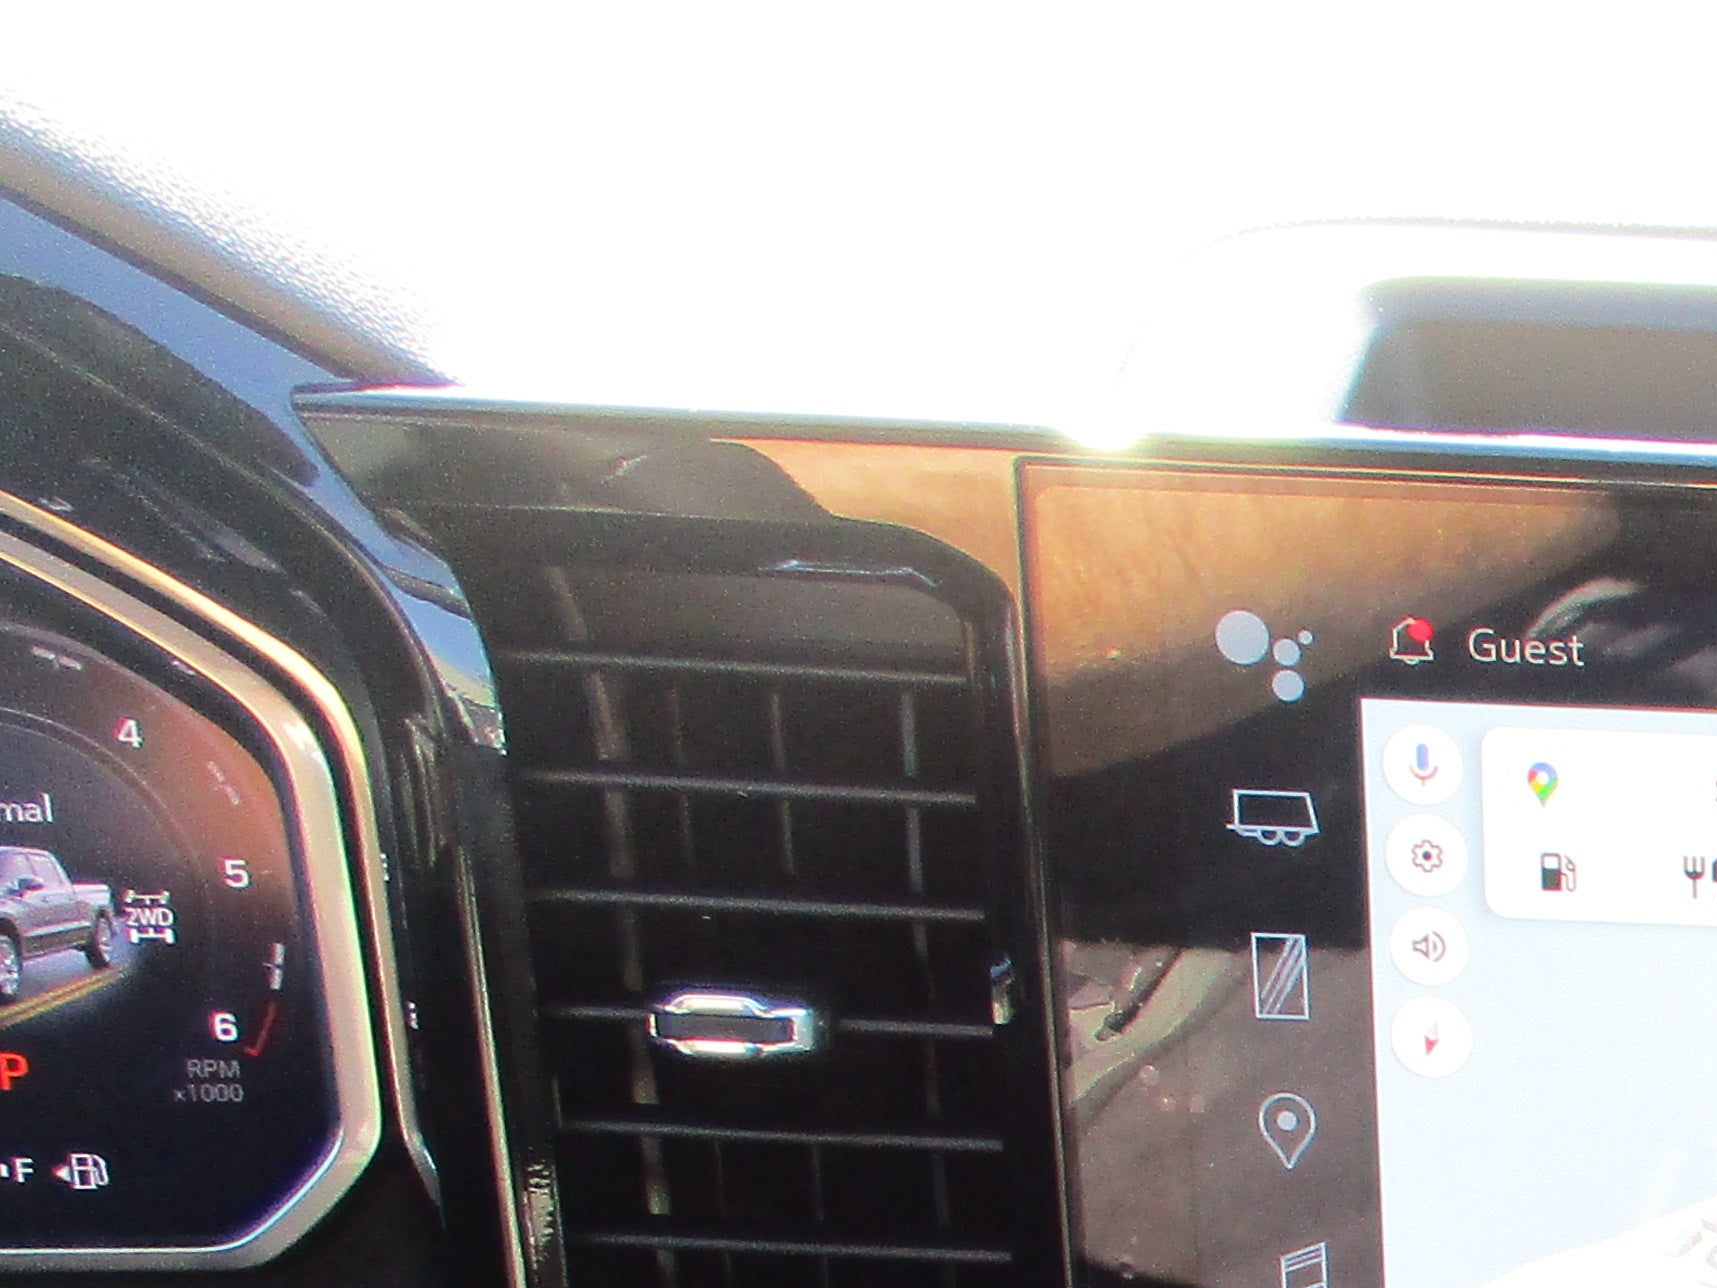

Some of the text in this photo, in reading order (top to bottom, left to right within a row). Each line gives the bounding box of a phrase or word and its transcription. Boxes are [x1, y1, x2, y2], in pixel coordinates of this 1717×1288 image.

[1467, 628, 1586, 668] Guest
[114, 717, 143, 749] 4
[223, 859, 250, 889] 5
[123, 906, 174, 927] 2WD
[210, 1012, 238, 1042] 6
[0, 1051, 30, 1091] P
[186, 1058, 242, 1079] RPM
[174, 1082, 244, 1103] x1000
[13, 1156, 36, 1184] F
